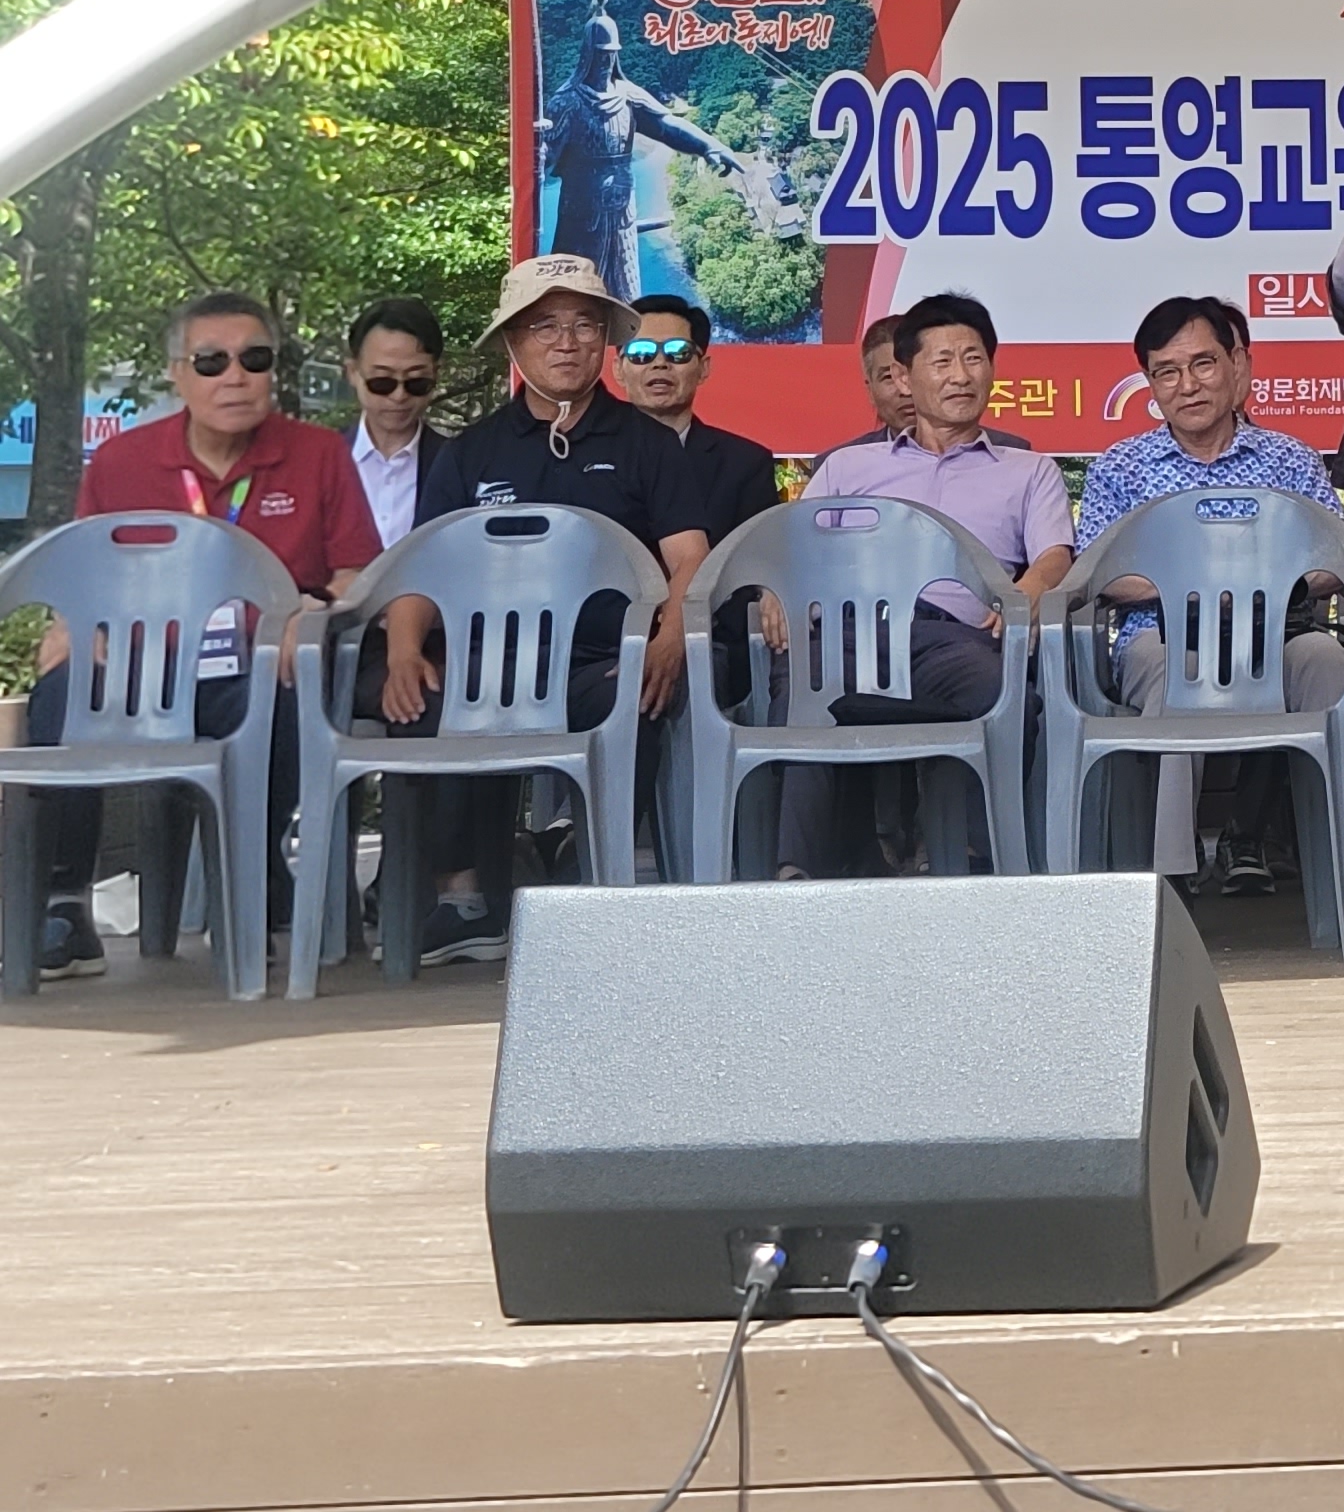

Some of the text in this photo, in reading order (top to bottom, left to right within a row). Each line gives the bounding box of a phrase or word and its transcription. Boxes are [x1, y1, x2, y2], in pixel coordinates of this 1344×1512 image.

[645, 10, 832, 52] 최초의 통제영!
[816, 76, 1053, 239] 2025
[1250, 404, 1296, 416] Cultural
